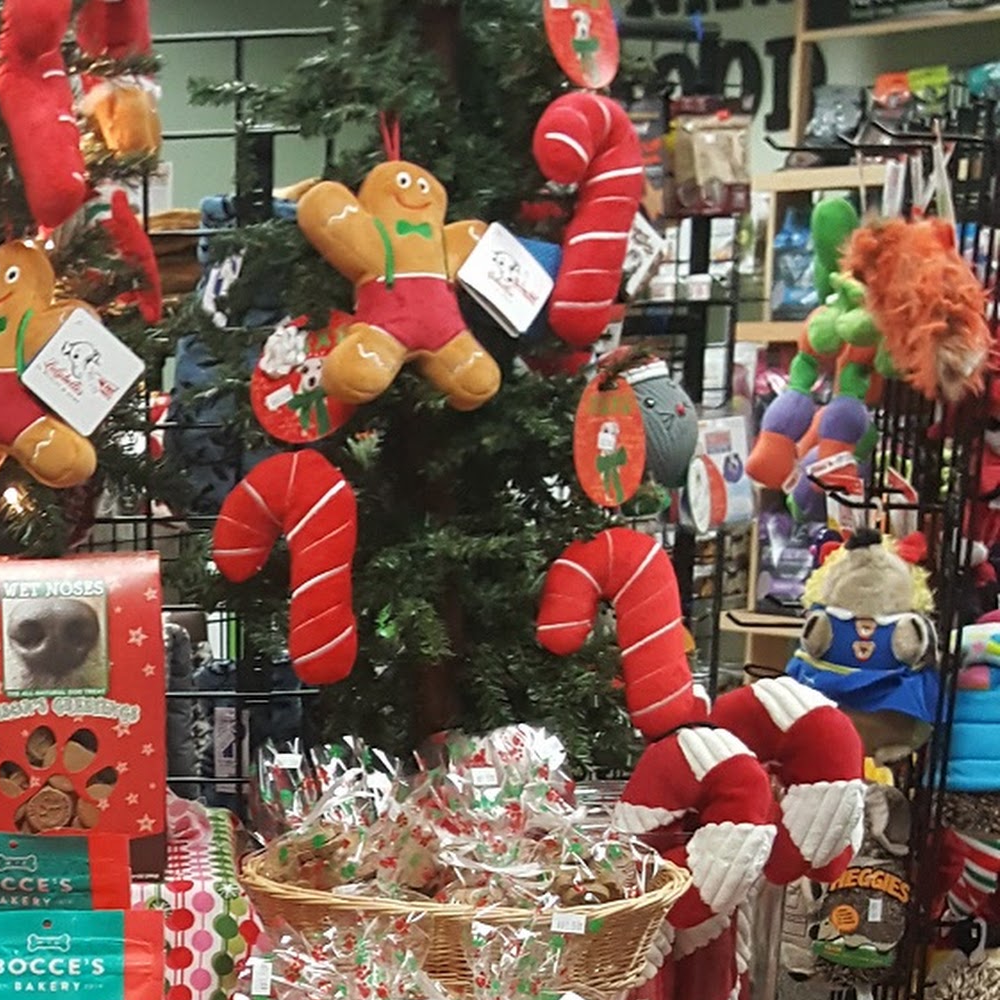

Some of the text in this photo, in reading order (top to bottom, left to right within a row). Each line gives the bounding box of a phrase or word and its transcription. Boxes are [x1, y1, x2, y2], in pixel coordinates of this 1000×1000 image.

[3, 580, 105, 597] WET NOSES
[14, 981, 81, 993] BAKERY
